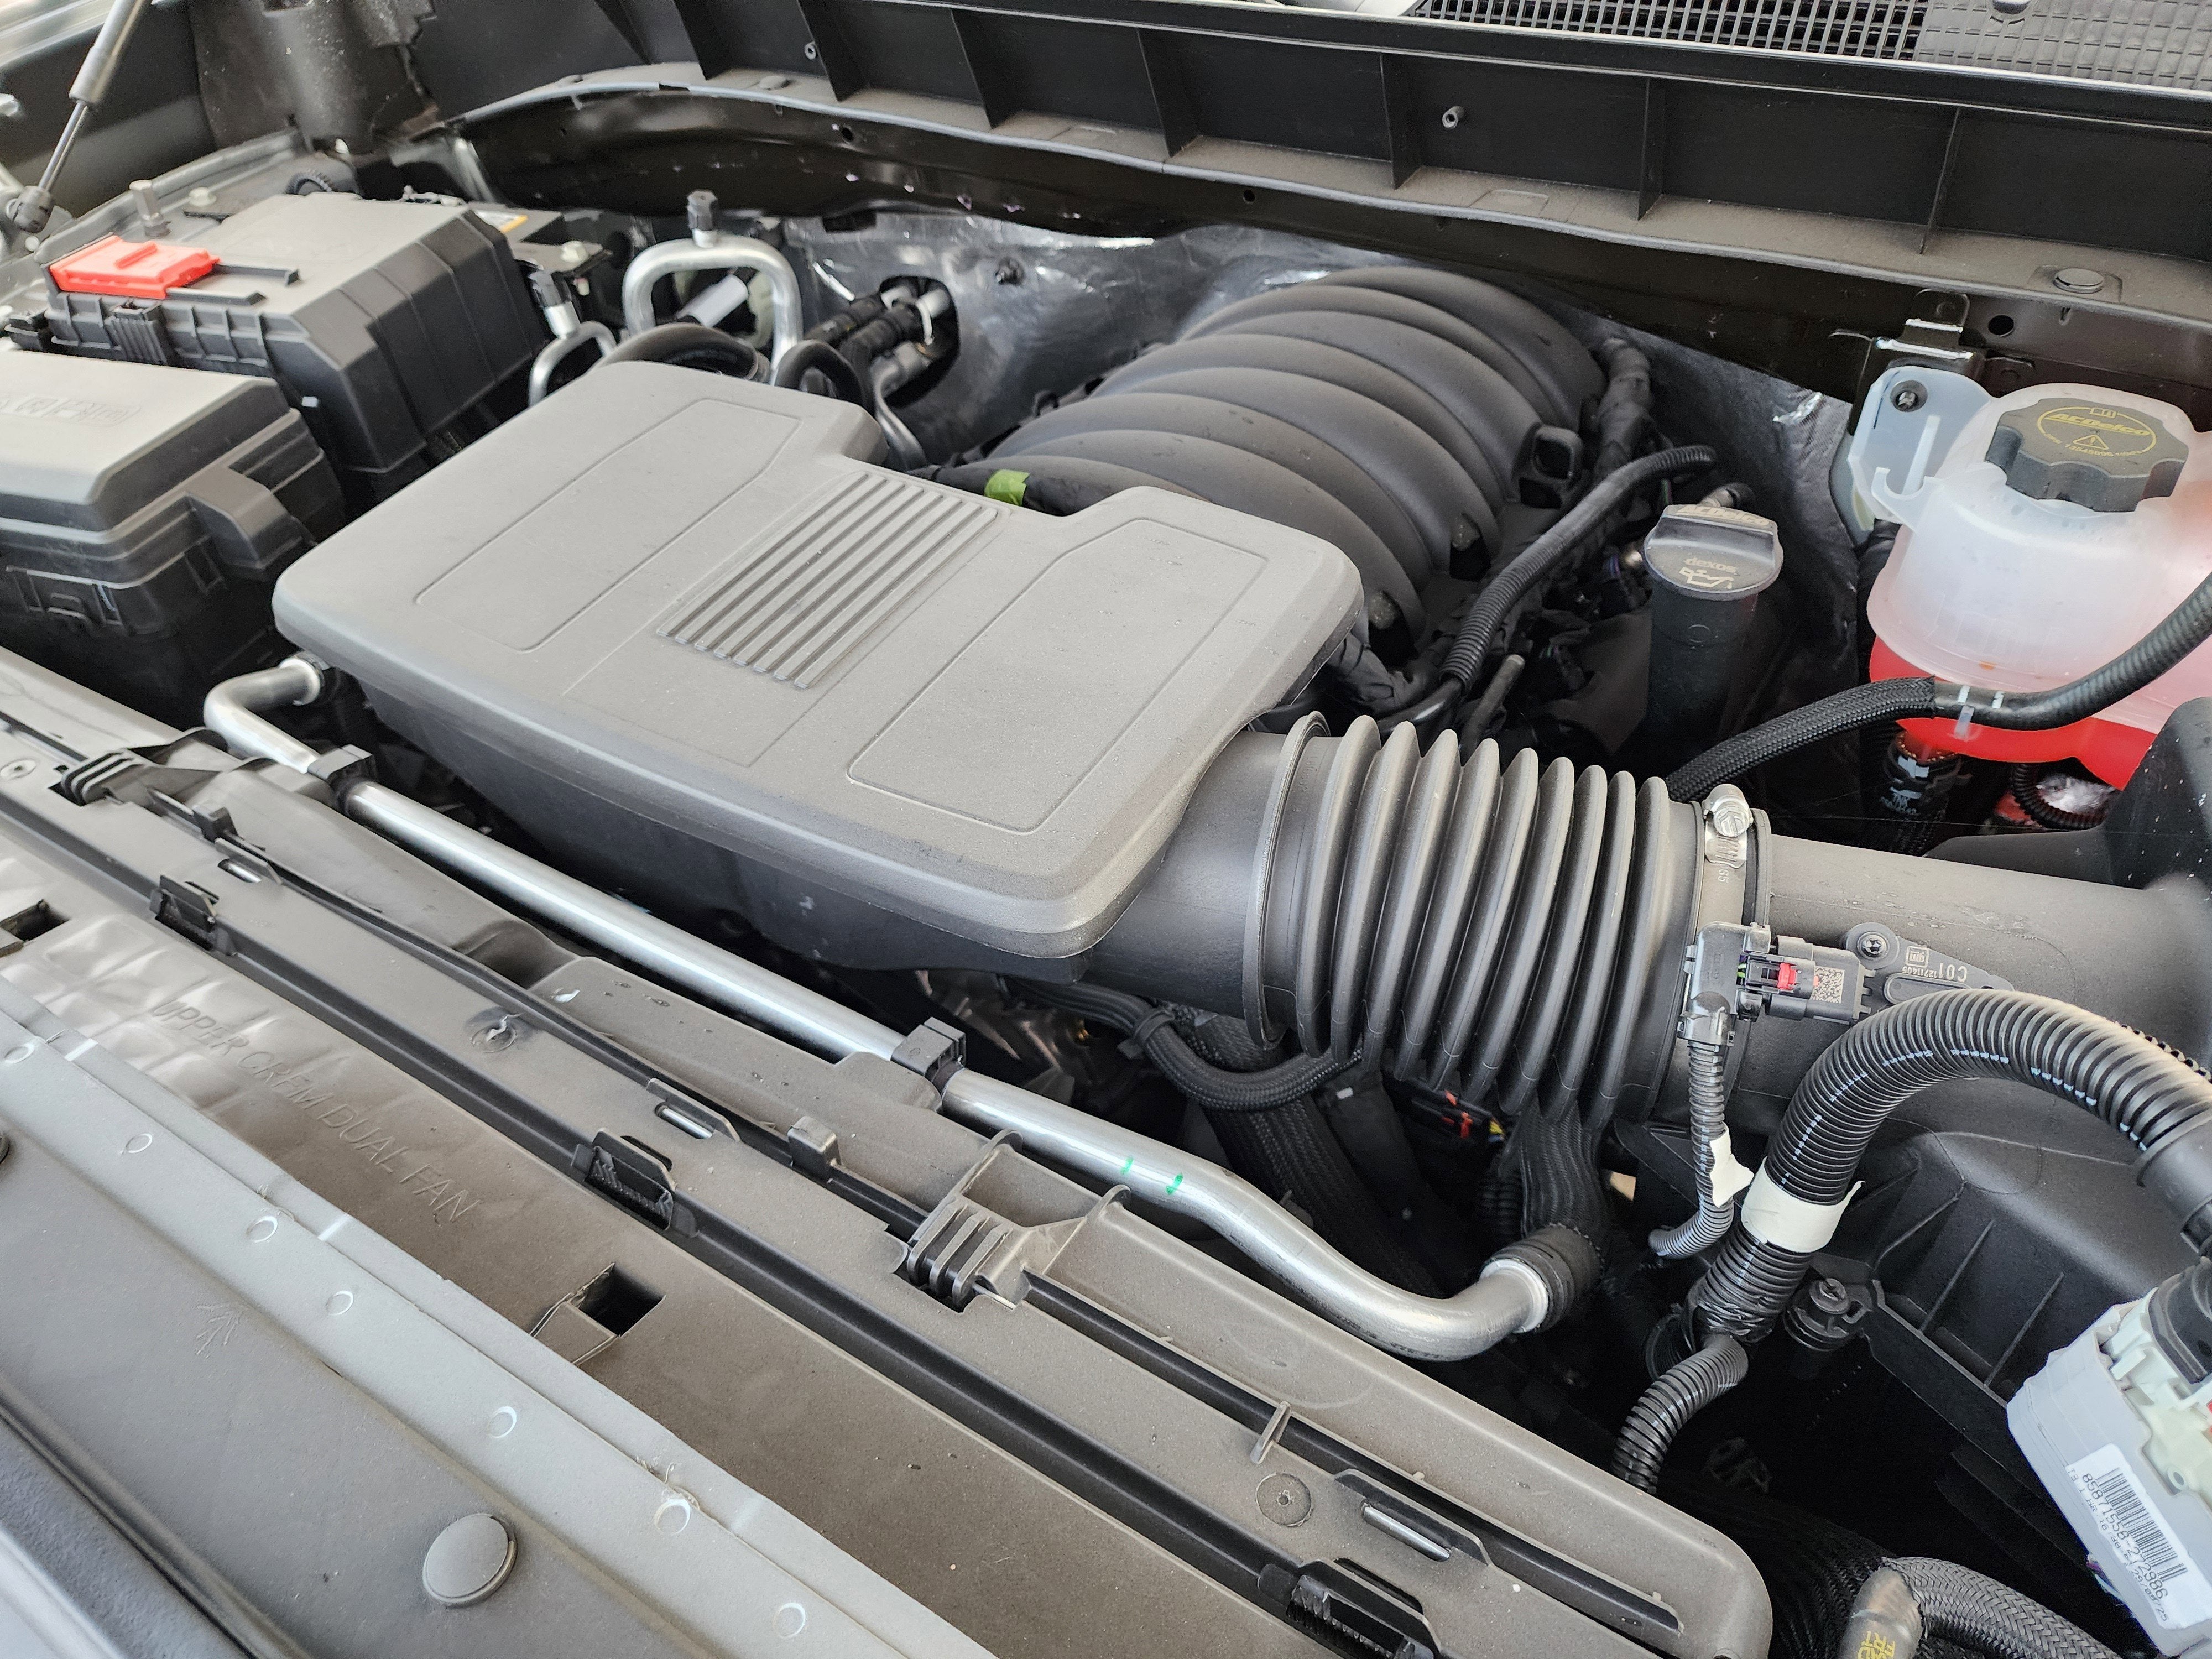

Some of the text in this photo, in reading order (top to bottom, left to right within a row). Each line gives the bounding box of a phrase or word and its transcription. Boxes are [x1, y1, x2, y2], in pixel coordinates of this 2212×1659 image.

[2045, 413, 2151, 436] ACDelco
[1676, 505, 1770, 526] ACDelco
[1684, 557, 1738, 573] dexos
[1902, 963, 1968, 983] C01 12711405
[148, 1001, 251, 1056] UPPER
[317, 1103, 409, 1173] DUAL
[398, 1163, 483, 1223] FAN
